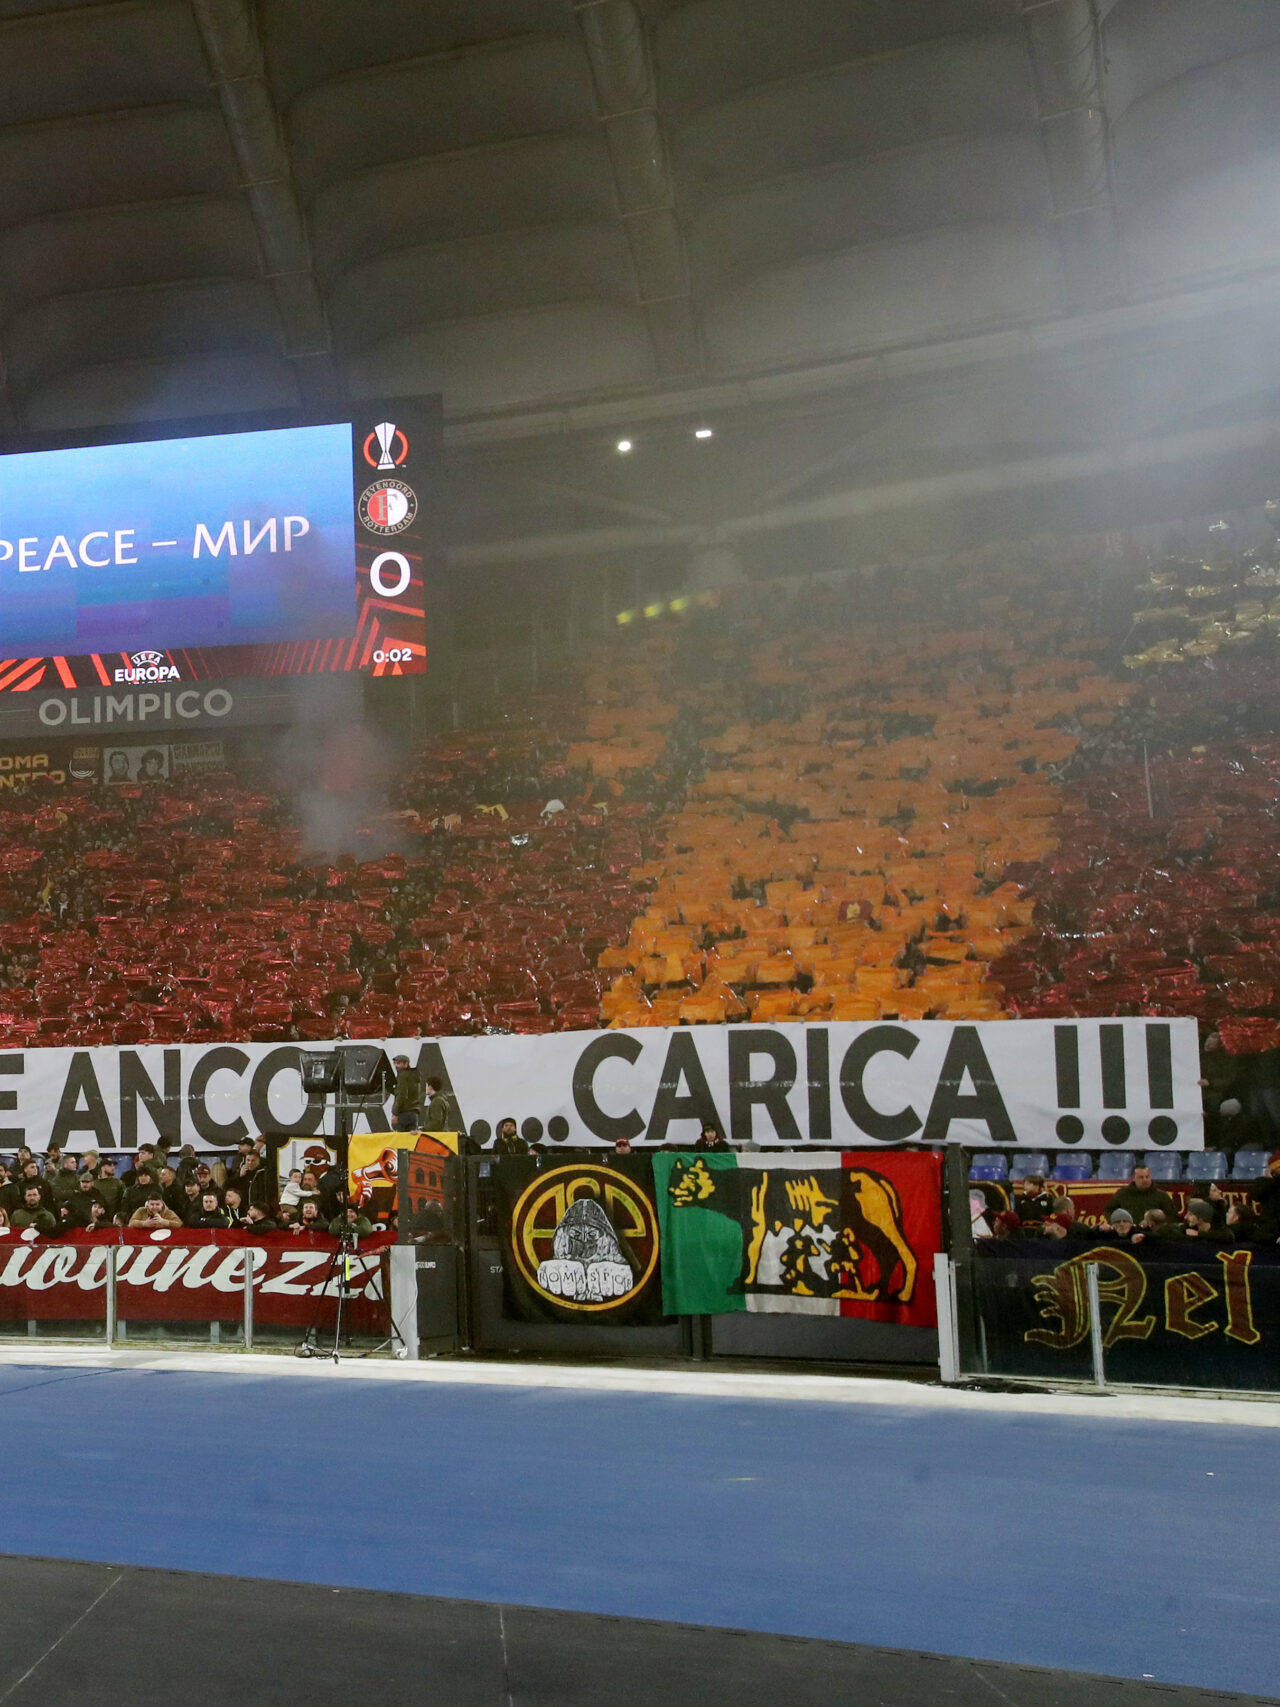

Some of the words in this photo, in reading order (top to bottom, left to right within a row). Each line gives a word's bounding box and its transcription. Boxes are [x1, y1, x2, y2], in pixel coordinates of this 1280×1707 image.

[362, 481, 413, 502] FEYENOORD
[192, 514, 310, 559] МИР
[362, 512, 414, 533] ROTTERDAM
[368, 551, 411, 597] 0
[132, 653, 161, 665] UEFA
[372, 647, 413, 664] 0:02
[114, 665, 180, 682] EUROPA
[38, 688, 234, 727] OLIMPICO
[1053, 1022, 1179, 1146] !!!
[1023, 1244, 1262, 1349] Nel
